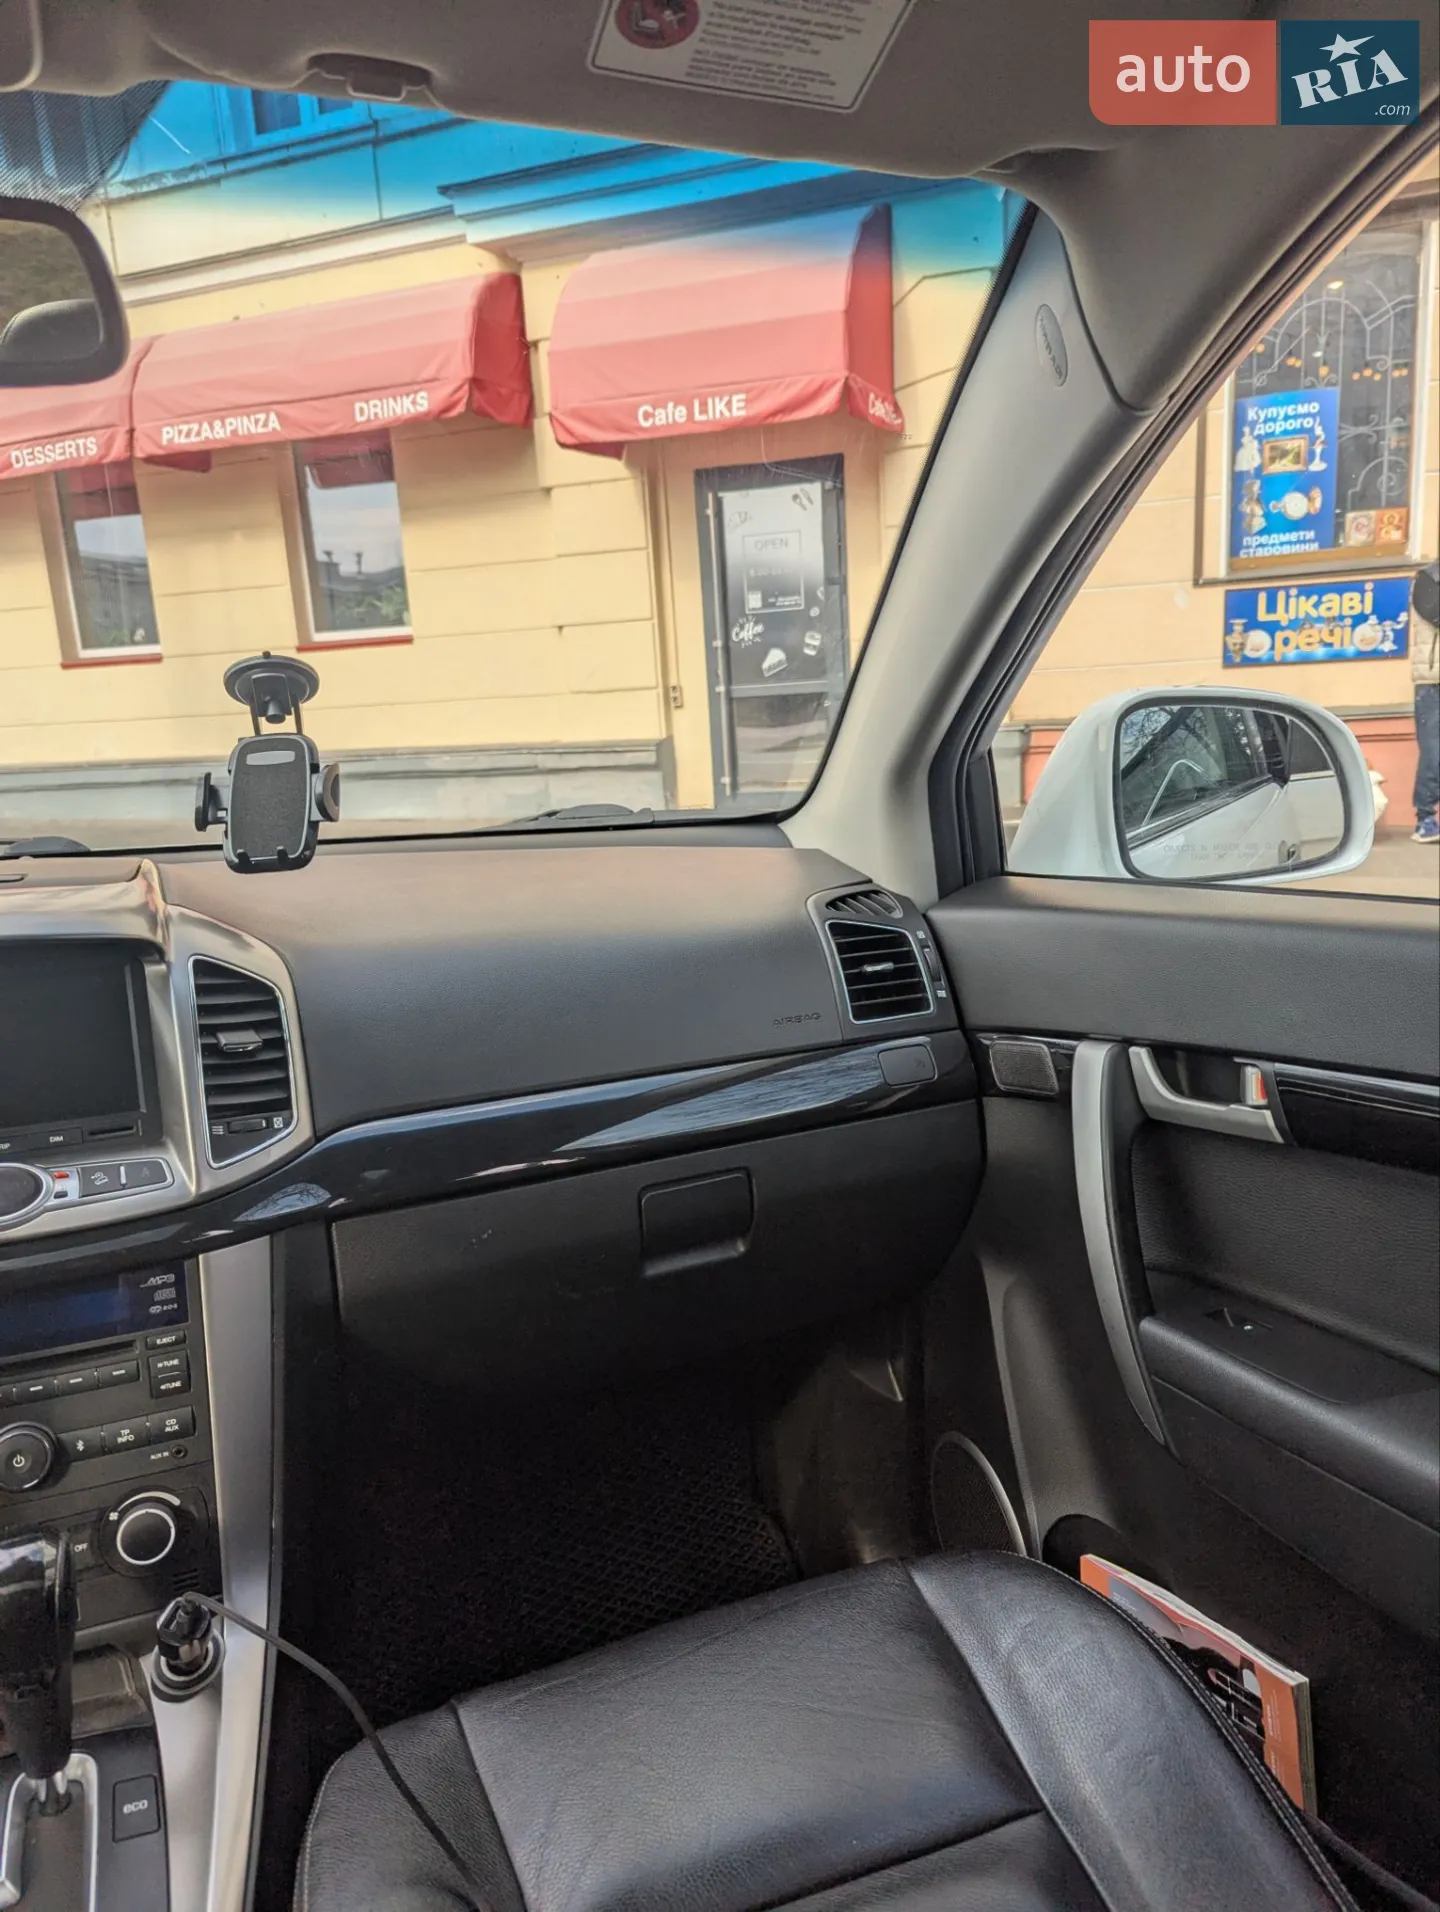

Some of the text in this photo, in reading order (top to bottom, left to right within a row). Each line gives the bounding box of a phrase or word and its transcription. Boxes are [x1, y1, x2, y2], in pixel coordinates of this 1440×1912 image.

[354, 391, 429, 423] DRINKS
[637, 394, 748, 427] Cafe LIKE
[1247, 402, 1320, 424] Купуємо
[161, 412, 281, 446] PIZZA&PINZA
[1253, 416, 1315, 436] дорого
[10, 436, 98, 470] DESSERTS
[1243, 529, 1316, 548] предмети
[1256, 582, 1375, 627] Цікаві
[1274, 618, 1353, 662] речі
[773, 1012, 822, 1028] AIRBAG
[74, 1542, 89, 1552] OFF
[122, 1799, 149, 1814] eco
